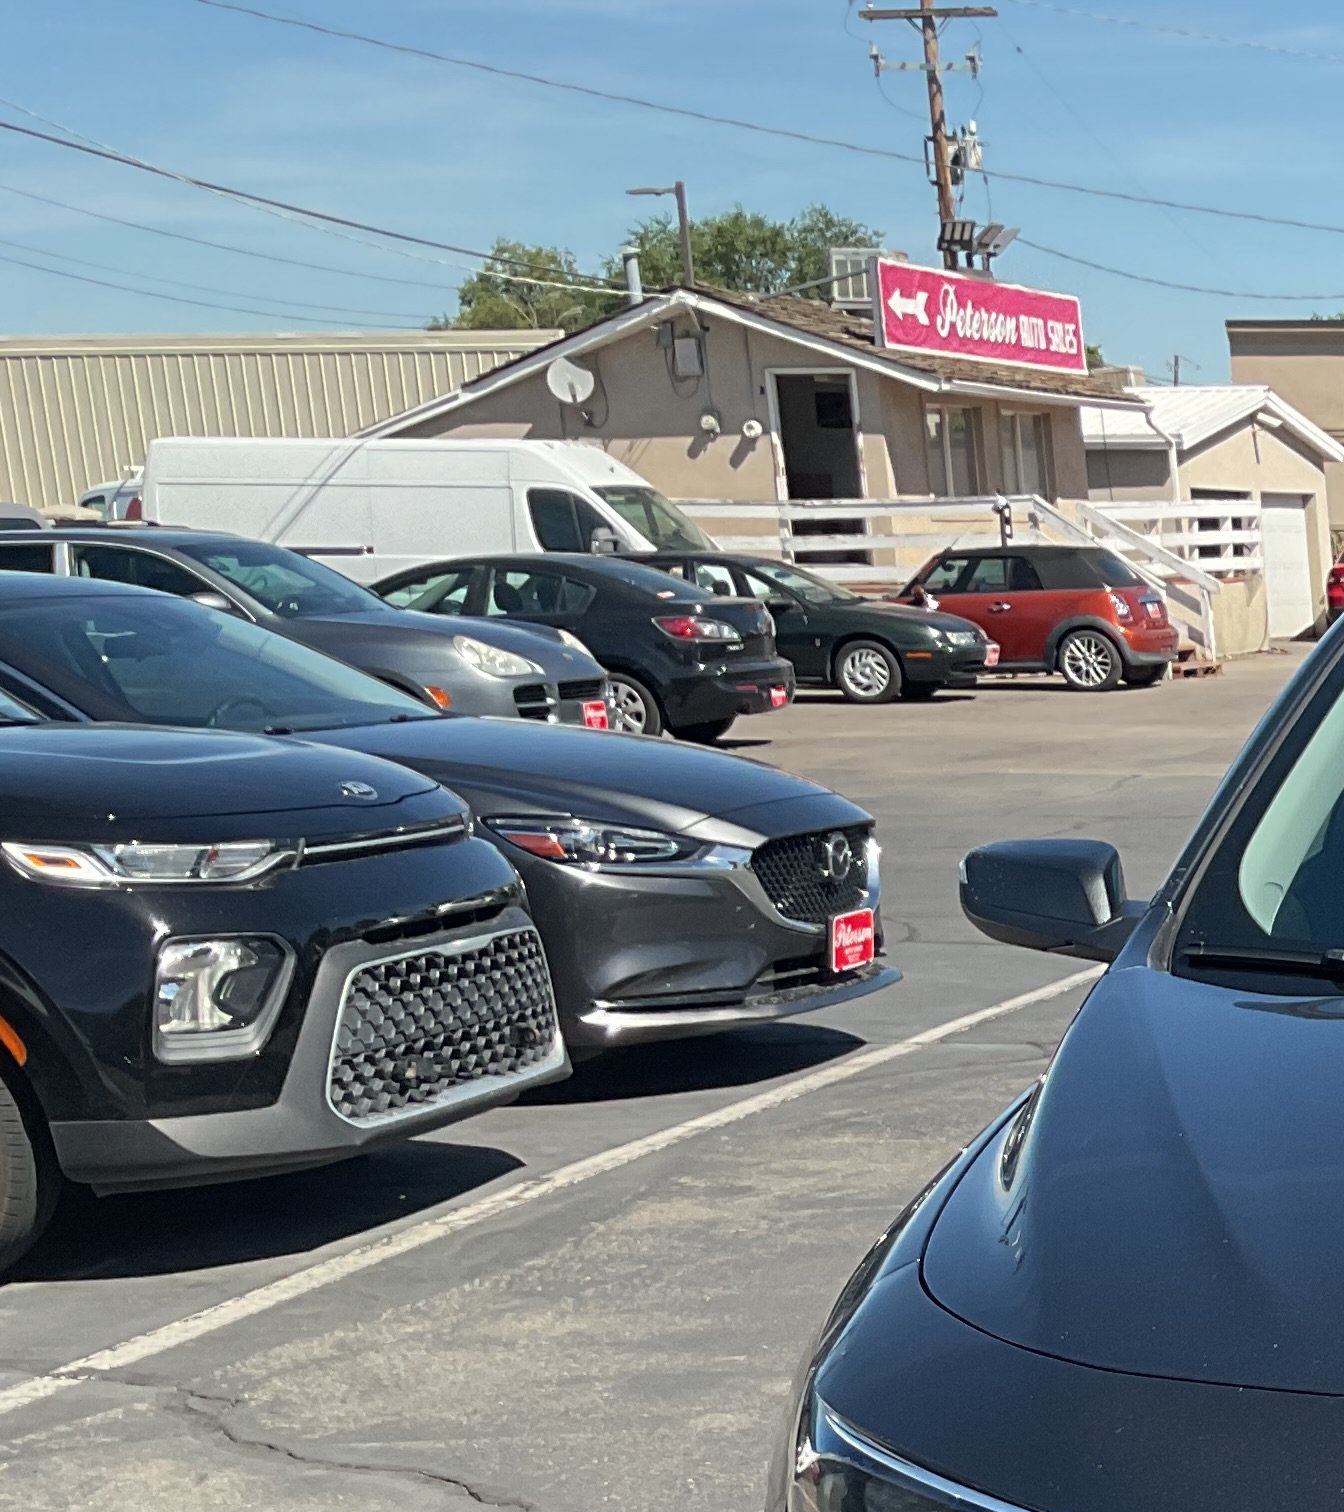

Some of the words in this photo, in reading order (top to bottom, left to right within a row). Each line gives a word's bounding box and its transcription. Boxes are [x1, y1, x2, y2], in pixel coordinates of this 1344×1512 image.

[937, 283, 1017, 345] Peterson
[1019, 314, 1046, 351] AUTO
[1048, 319, 1078, 355] SALES
